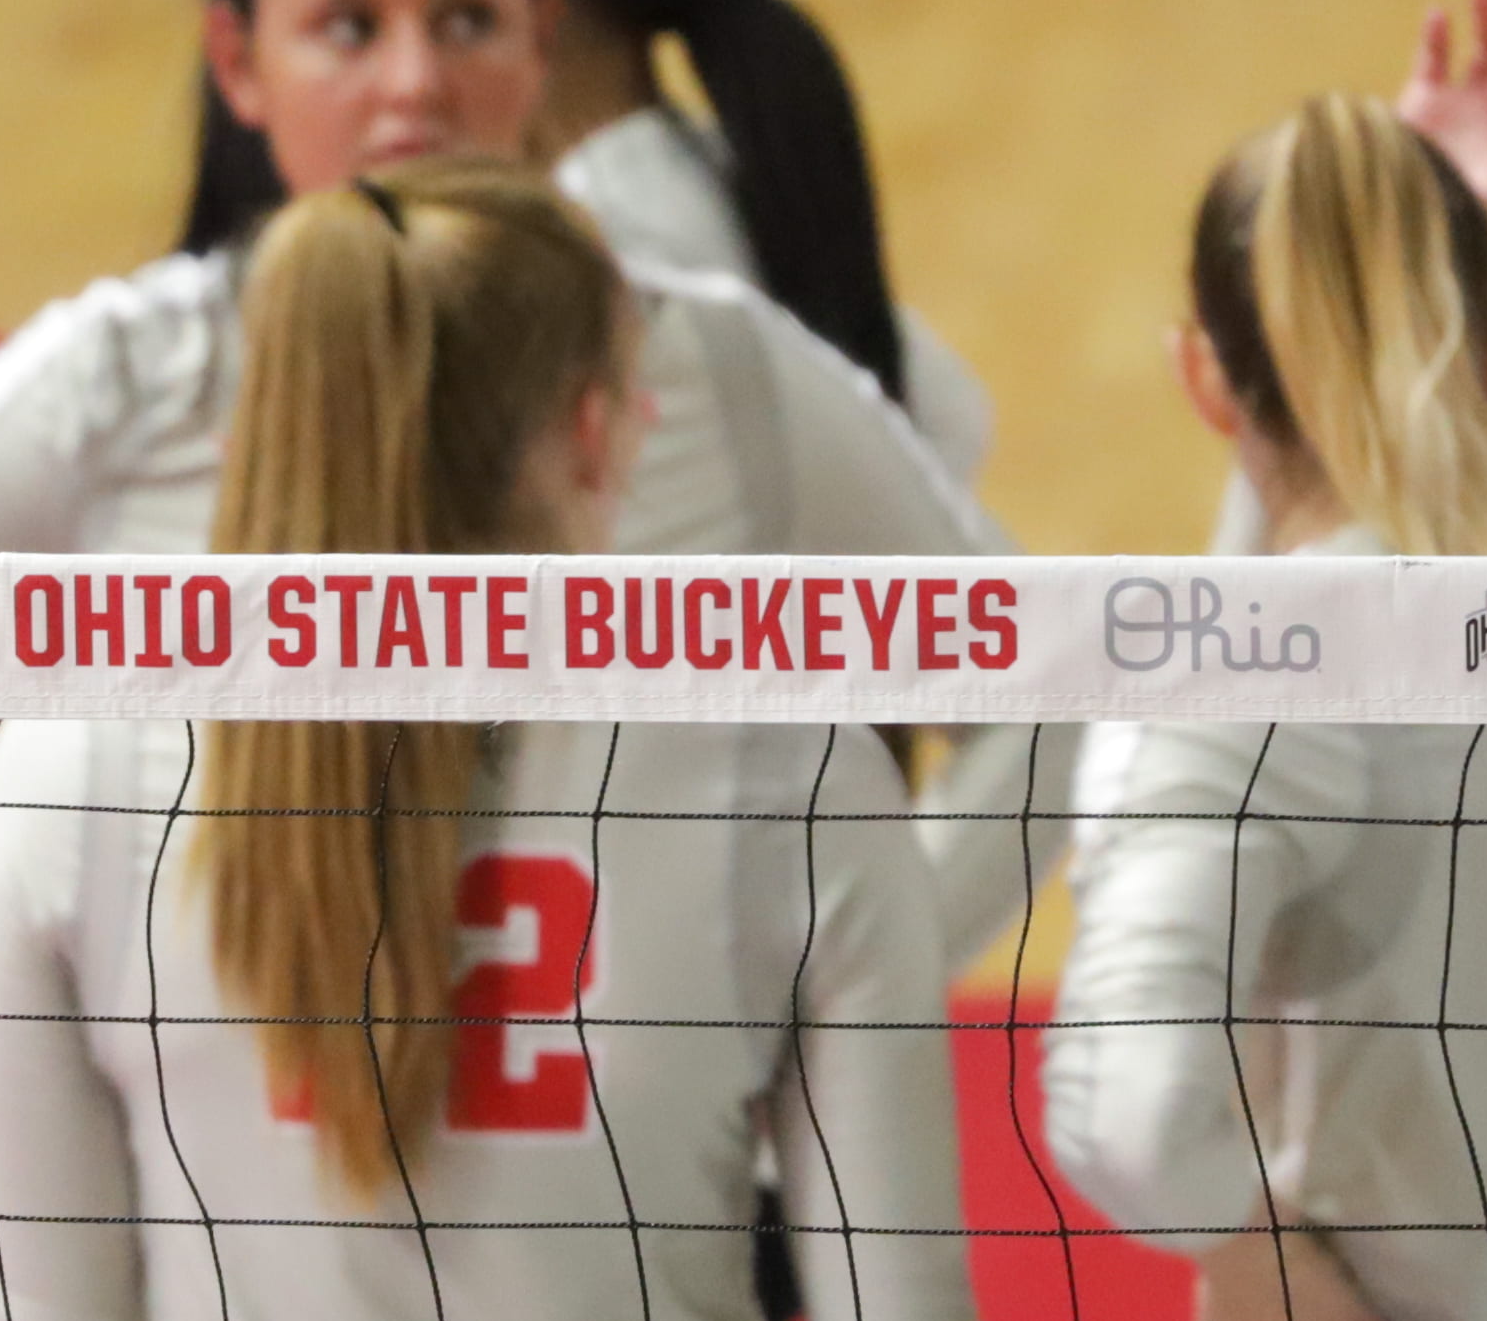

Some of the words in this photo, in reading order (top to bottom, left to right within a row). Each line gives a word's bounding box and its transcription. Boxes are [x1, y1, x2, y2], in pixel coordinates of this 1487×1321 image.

[15, 574, 231, 667] OHIO
[268, 575, 528, 668] STATE
[565, 577, 1016, 670] BUCKEYES
[1104, 576, 1321, 672] Ohio
